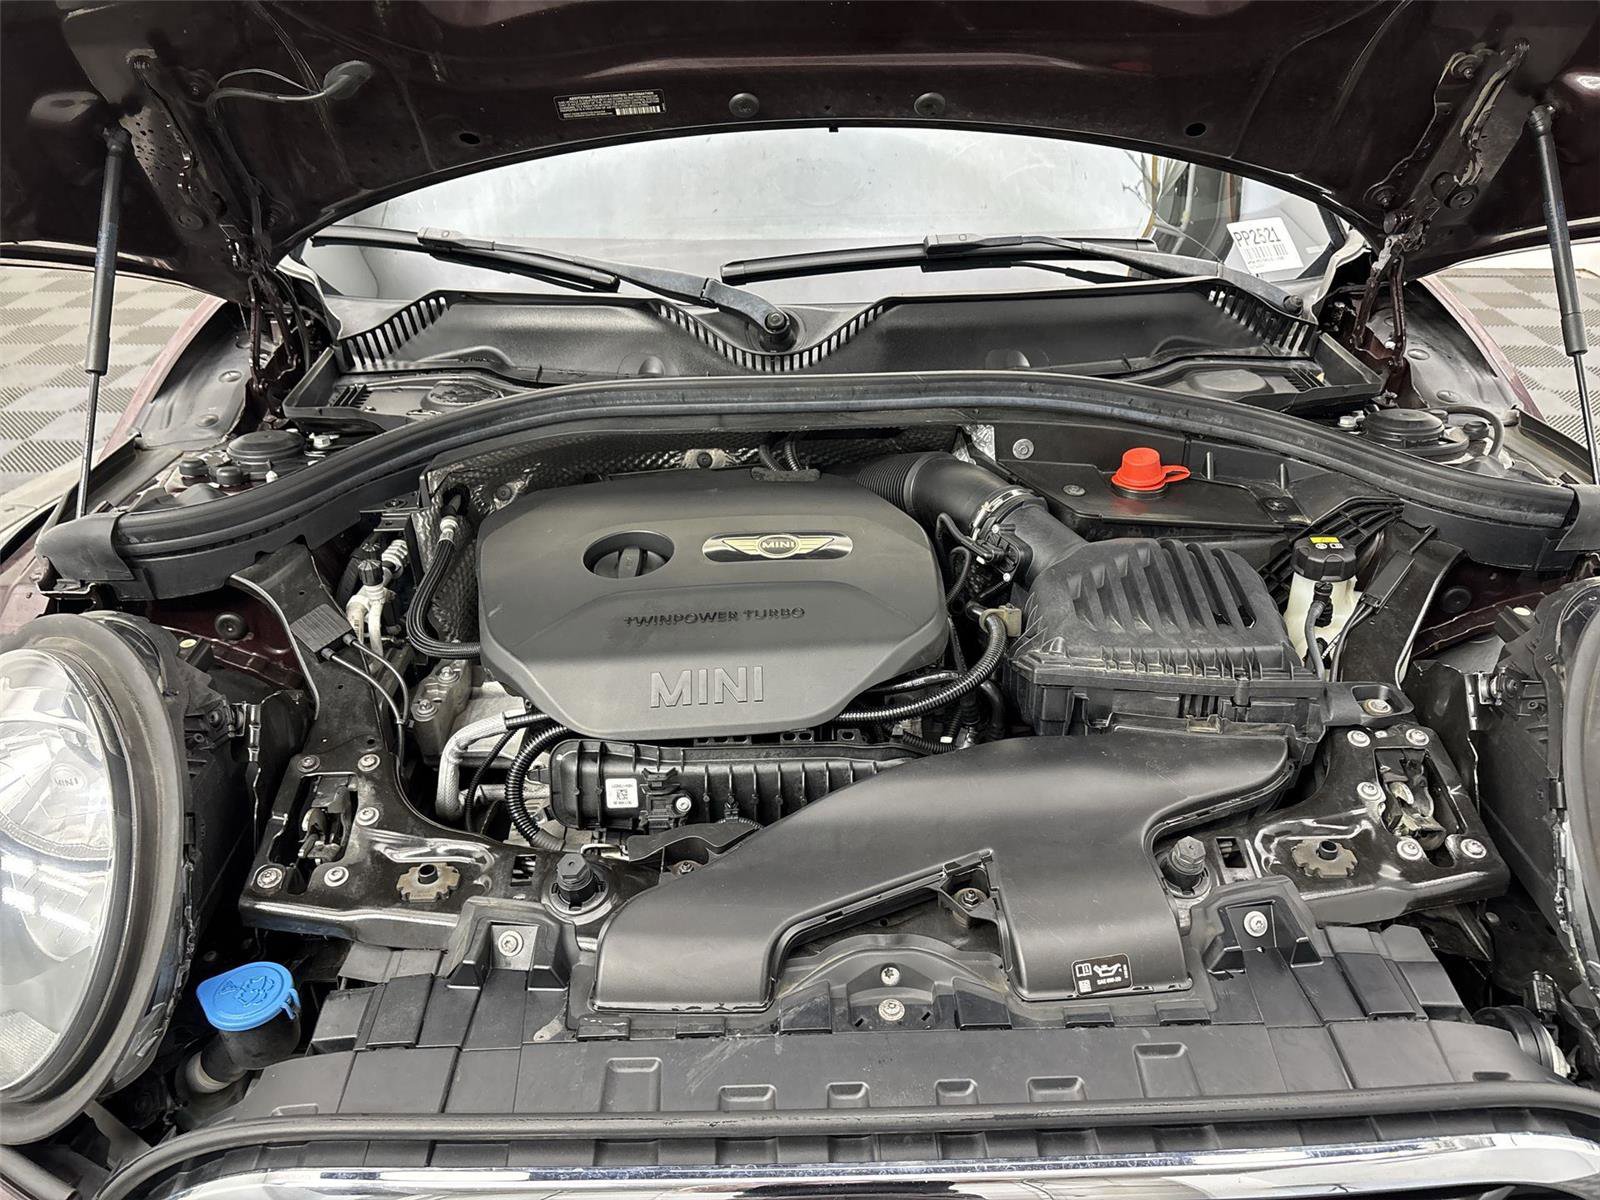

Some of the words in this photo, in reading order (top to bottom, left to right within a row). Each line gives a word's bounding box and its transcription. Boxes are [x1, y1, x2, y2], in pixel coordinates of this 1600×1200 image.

[1233, 227, 1281, 247] PP2521
[761, 540, 796, 549] MINI
[623, 610, 738, 627] TWINPOWER
[743, 607, 805, 622] TURBO
[650, 665, 764, 708] MINI
